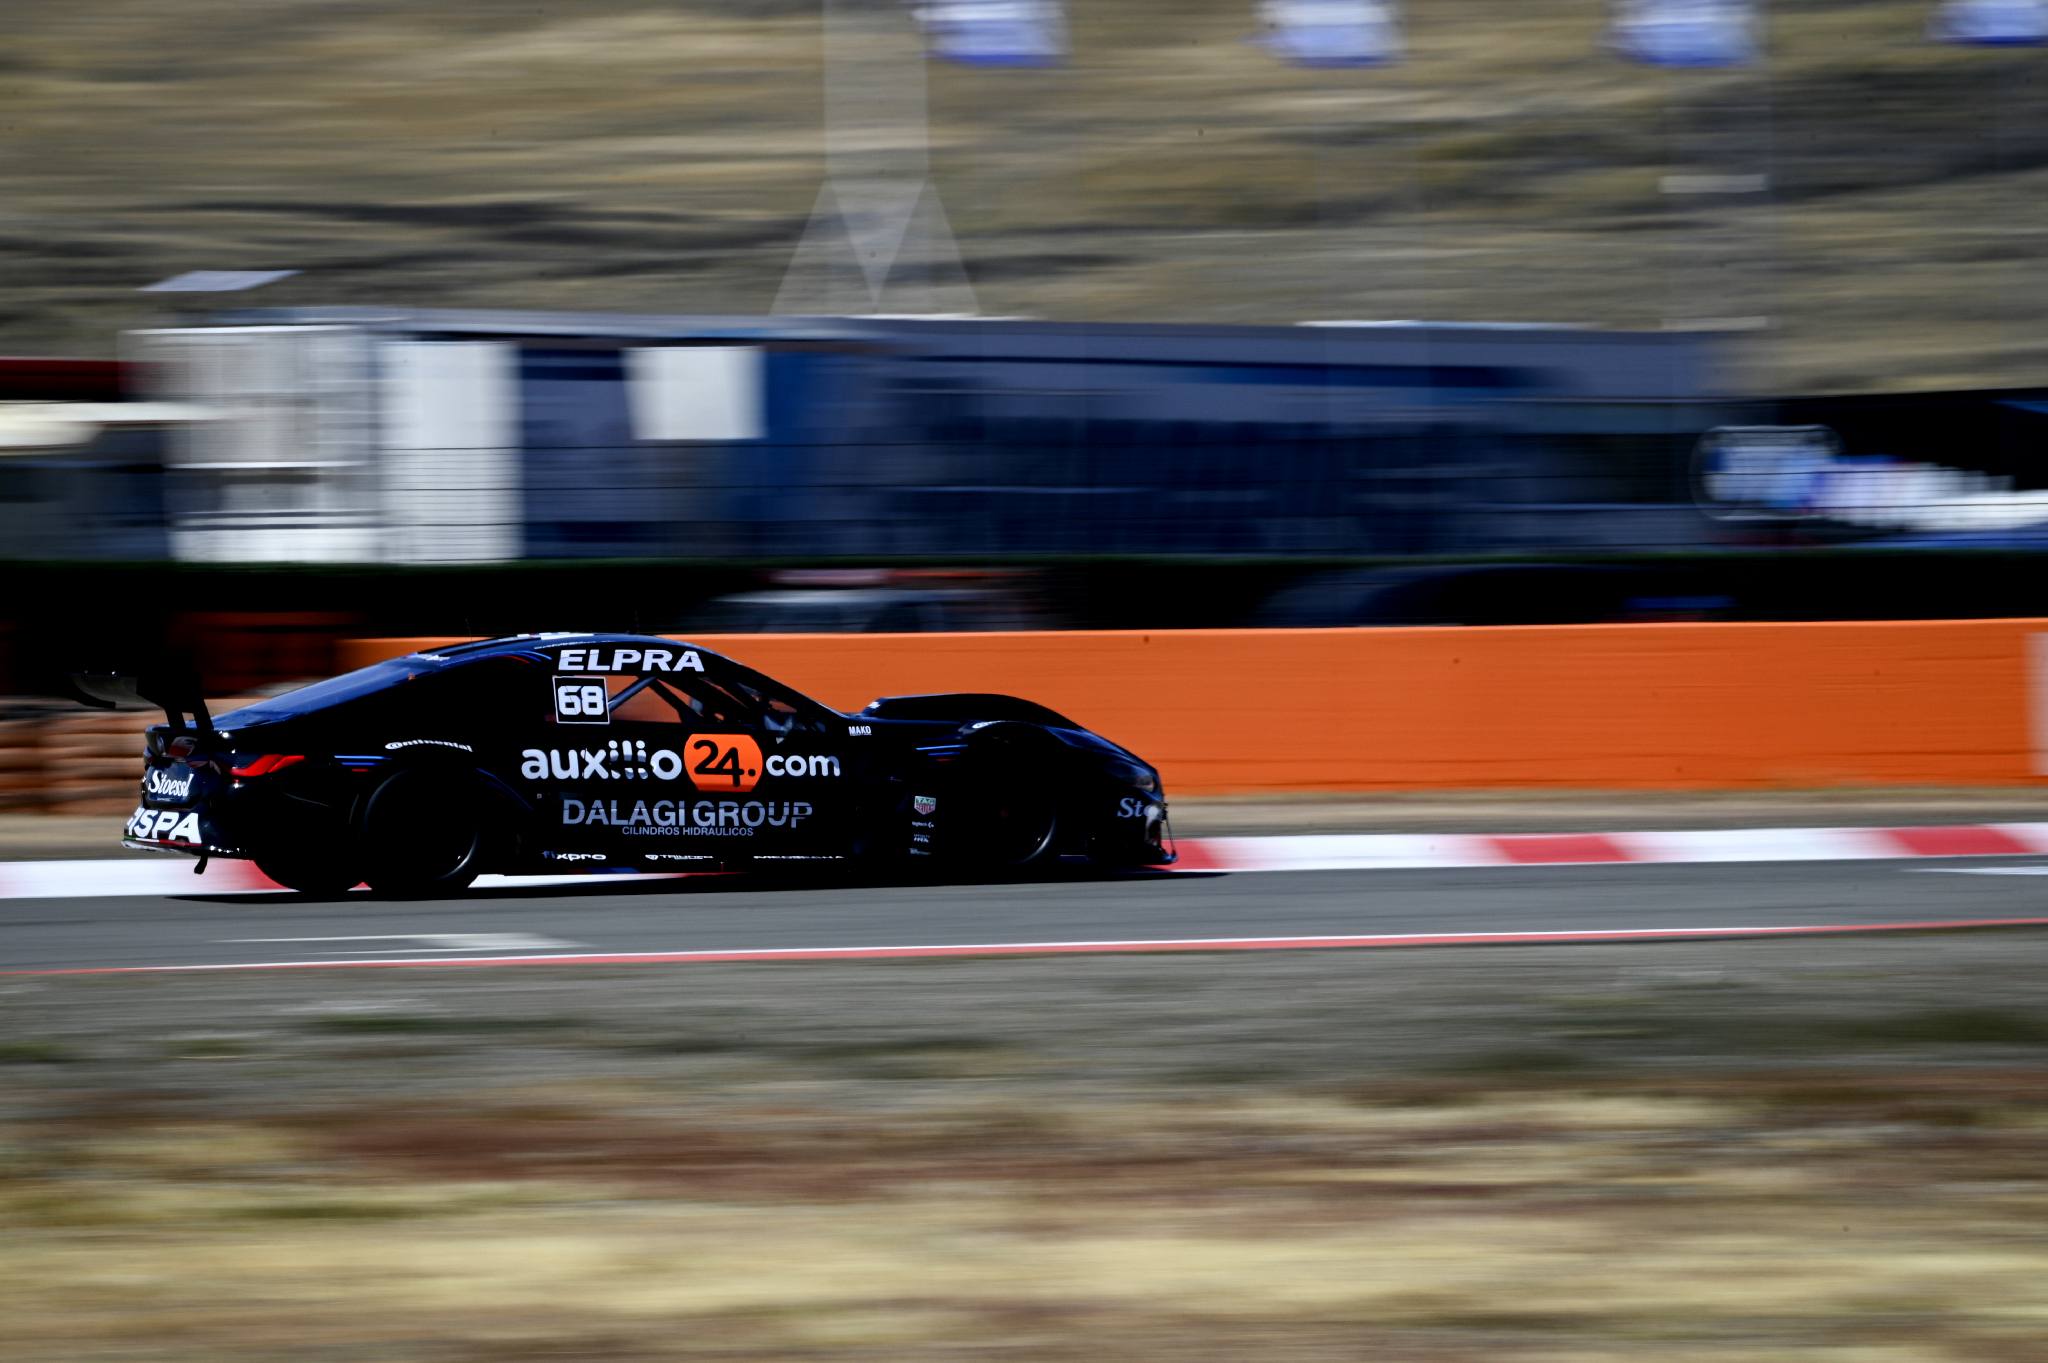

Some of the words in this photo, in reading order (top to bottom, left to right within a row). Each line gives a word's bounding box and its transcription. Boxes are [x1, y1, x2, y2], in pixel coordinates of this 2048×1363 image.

[557, 649, 705, 672] ELPRA
[556, 685, 605, 716] 68
[848, 725, 872, 734] MAKO
[147, 769, 195, 798] Stoessl
[562, 799, 688, 826] DALAGI
[691, 801, 814, 829] GROUP
[621, 826, 680, 837] CILINDROS
[682, 827, 754, 838] HIDRAULICOS
